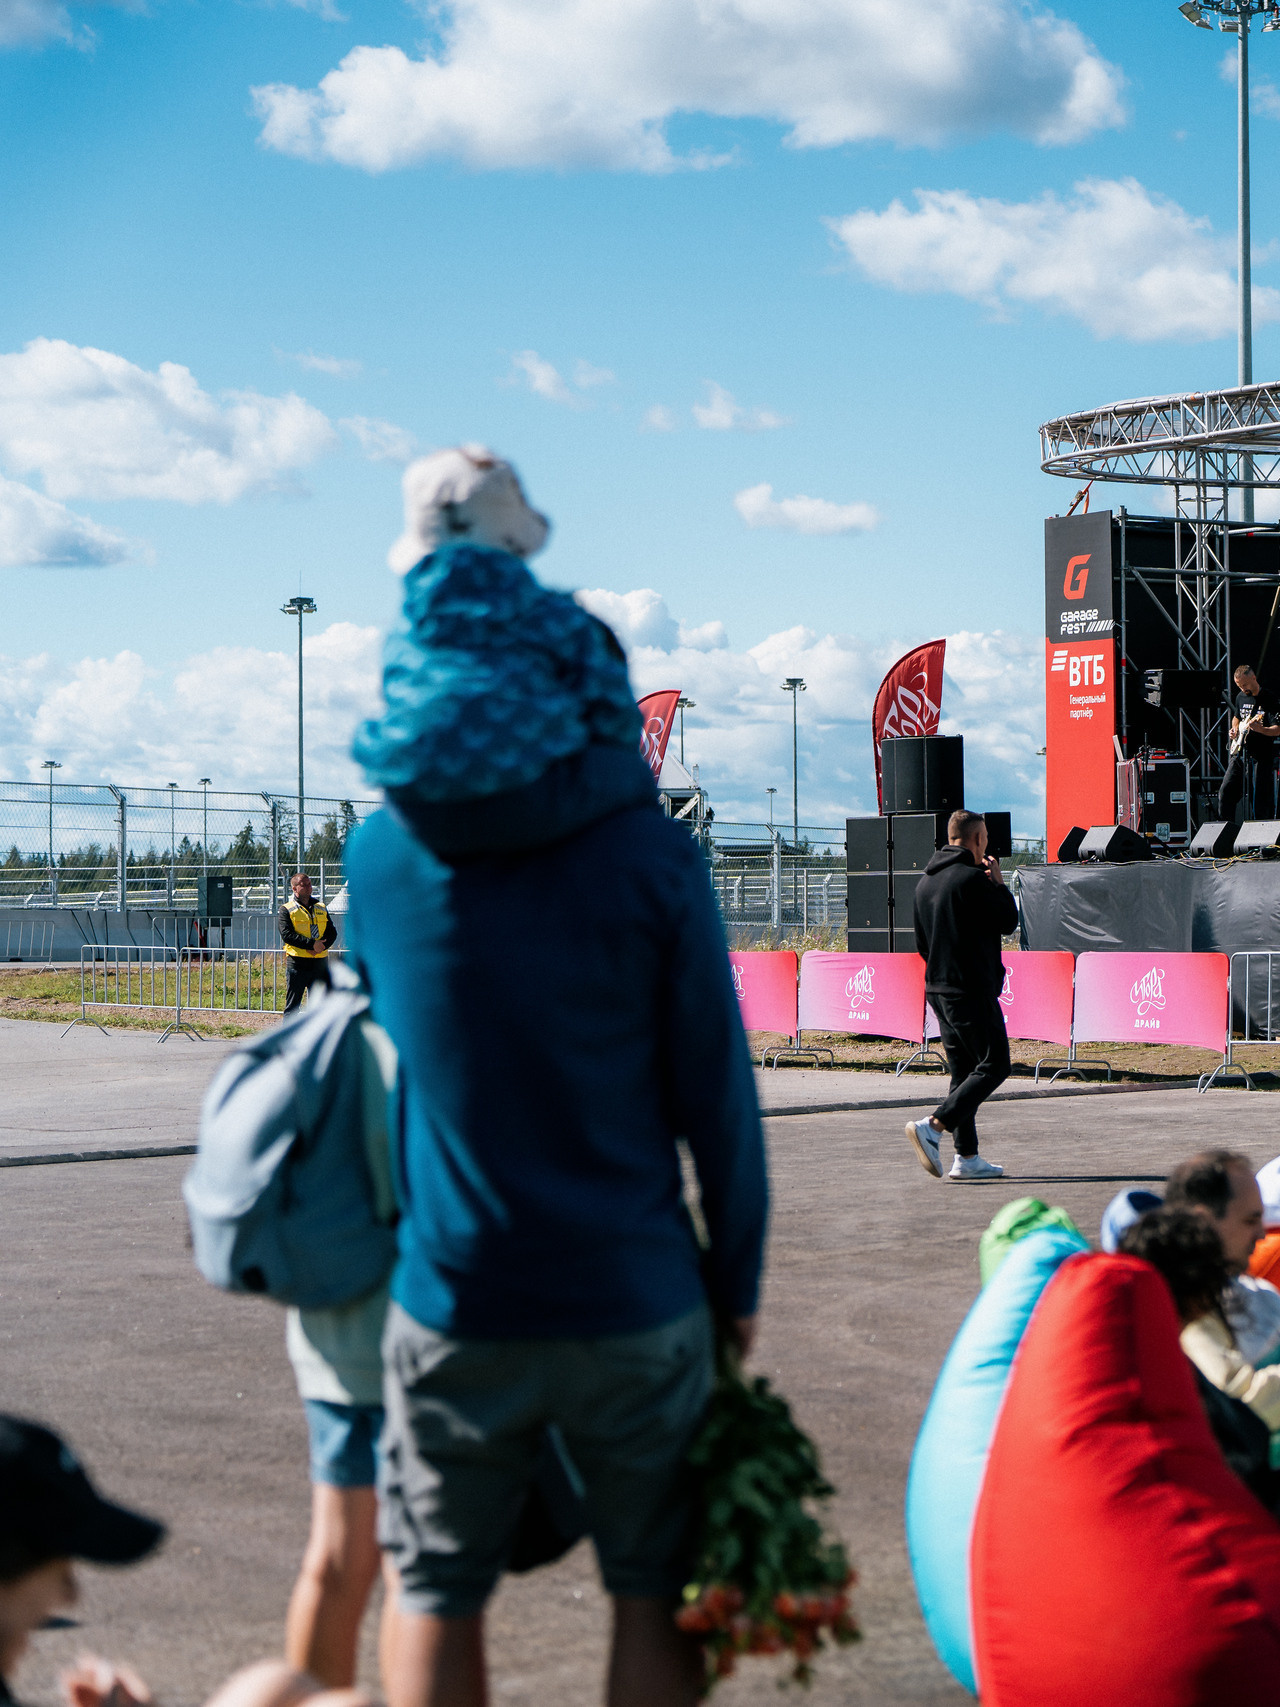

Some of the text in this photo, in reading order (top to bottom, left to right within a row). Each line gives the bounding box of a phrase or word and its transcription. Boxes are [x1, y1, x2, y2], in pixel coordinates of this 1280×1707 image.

[1069, 654, 1106, 687] ВТБ
[1069, 692, 1106, 706] Генеральный
[1069, 706, 1093, 721] партнёр
[848, 1010, 870, 1020] ДРАЙВ
[1134, 1018, 1161, 1029] ДРАЙВ
